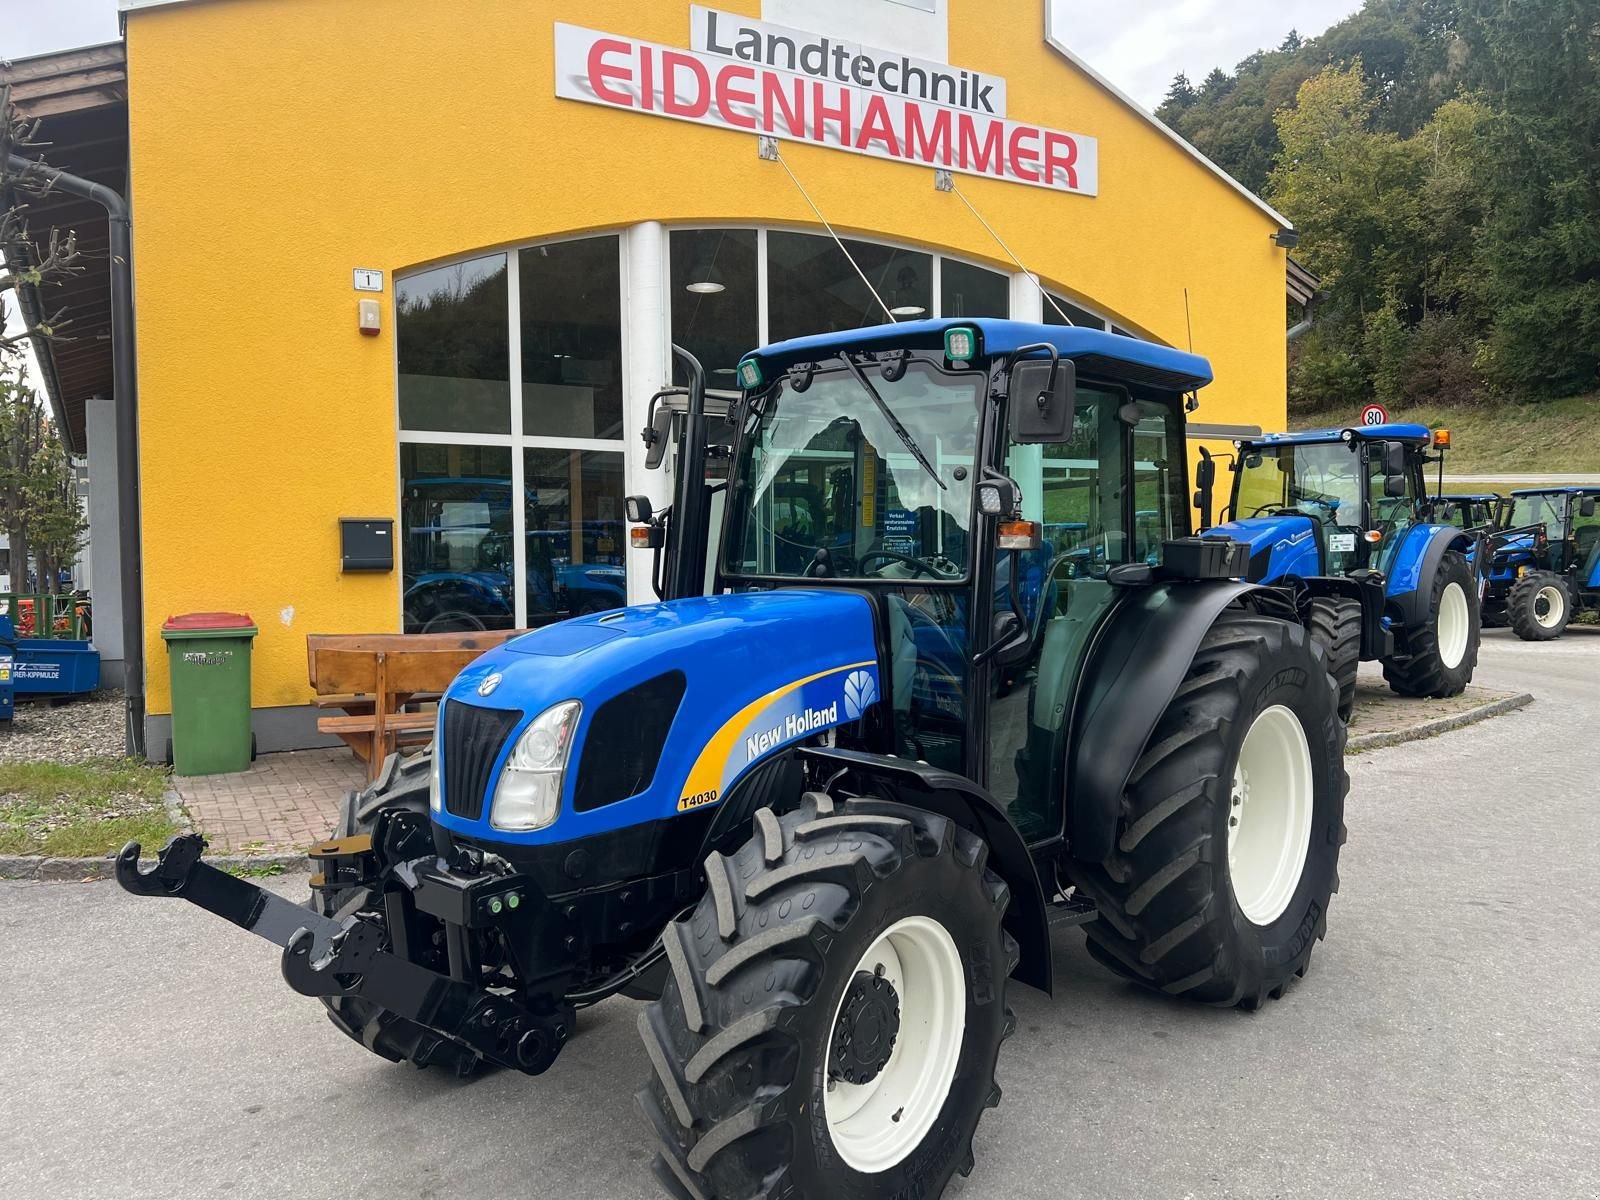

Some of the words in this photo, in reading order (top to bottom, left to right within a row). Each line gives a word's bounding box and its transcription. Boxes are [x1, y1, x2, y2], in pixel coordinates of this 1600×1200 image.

[706, 11, 994, 113] Landtechnik
[587, 38, 1079, 189] EIDENHAMMER
[366, 275, 370, 286] 1
[1367, 411, 1381, 425] 80
[13, 671, 60, 679] RER-KIPPMULDE
[745, 725, 782, 762] New
[785, 701, 837, 739] Holland
[681, 790, 717, 809] T4030
